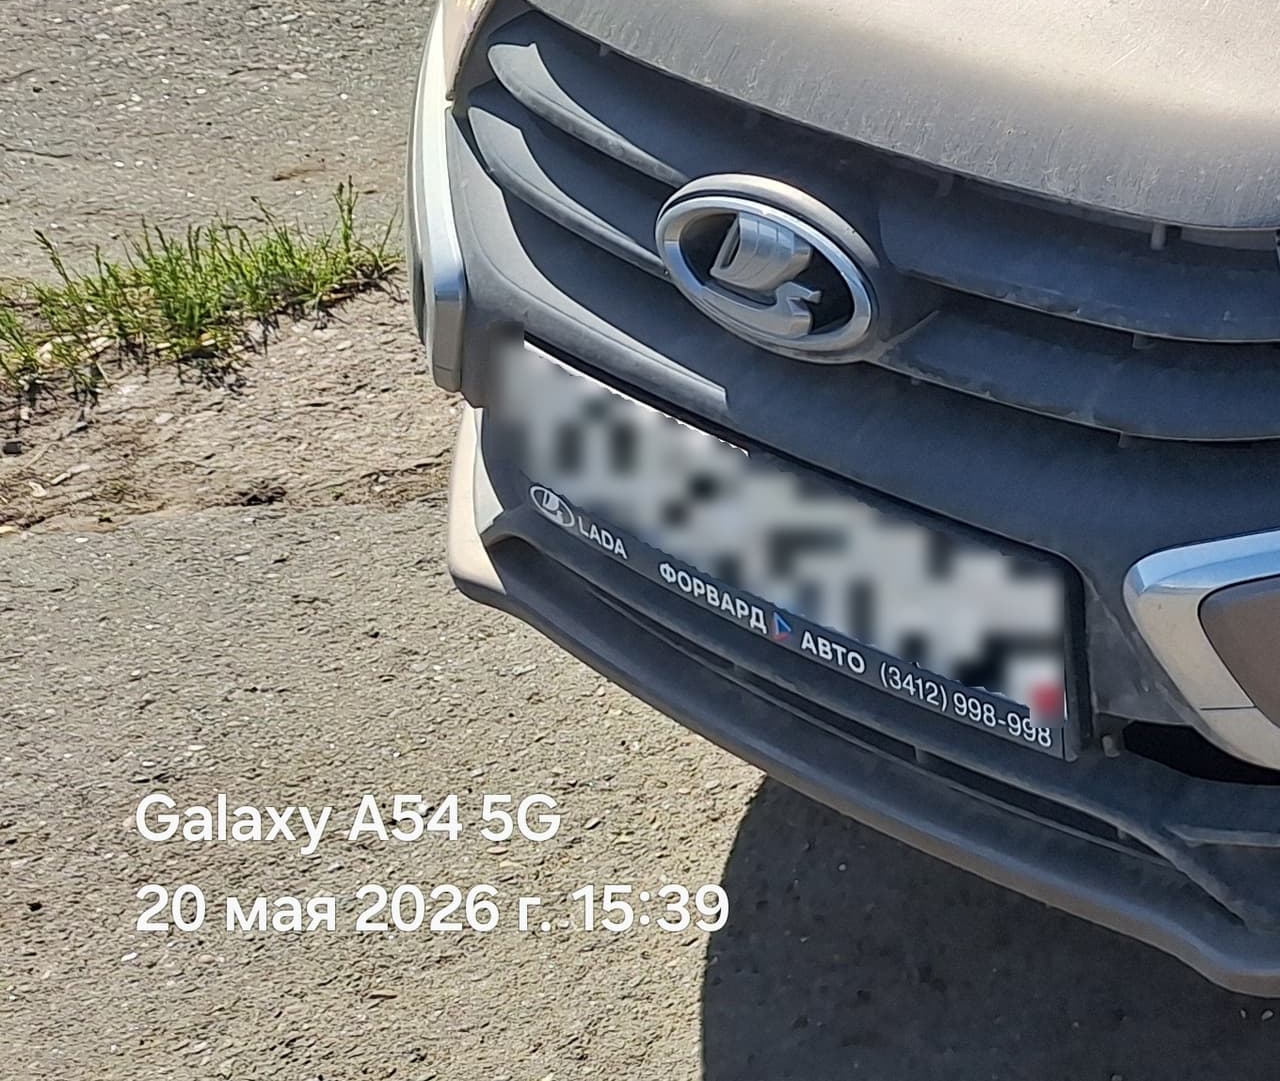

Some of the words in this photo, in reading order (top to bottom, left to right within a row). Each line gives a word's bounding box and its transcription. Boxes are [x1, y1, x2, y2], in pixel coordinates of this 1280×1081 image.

[577, 515, 628, 560] LADA
[659, 562, 768, 635] ФОРВАРД
[800, 630, 866, 675] АВТО
[880, 661, 949, 713] (3412)
[952, 691, 1053, 748] 998-998
